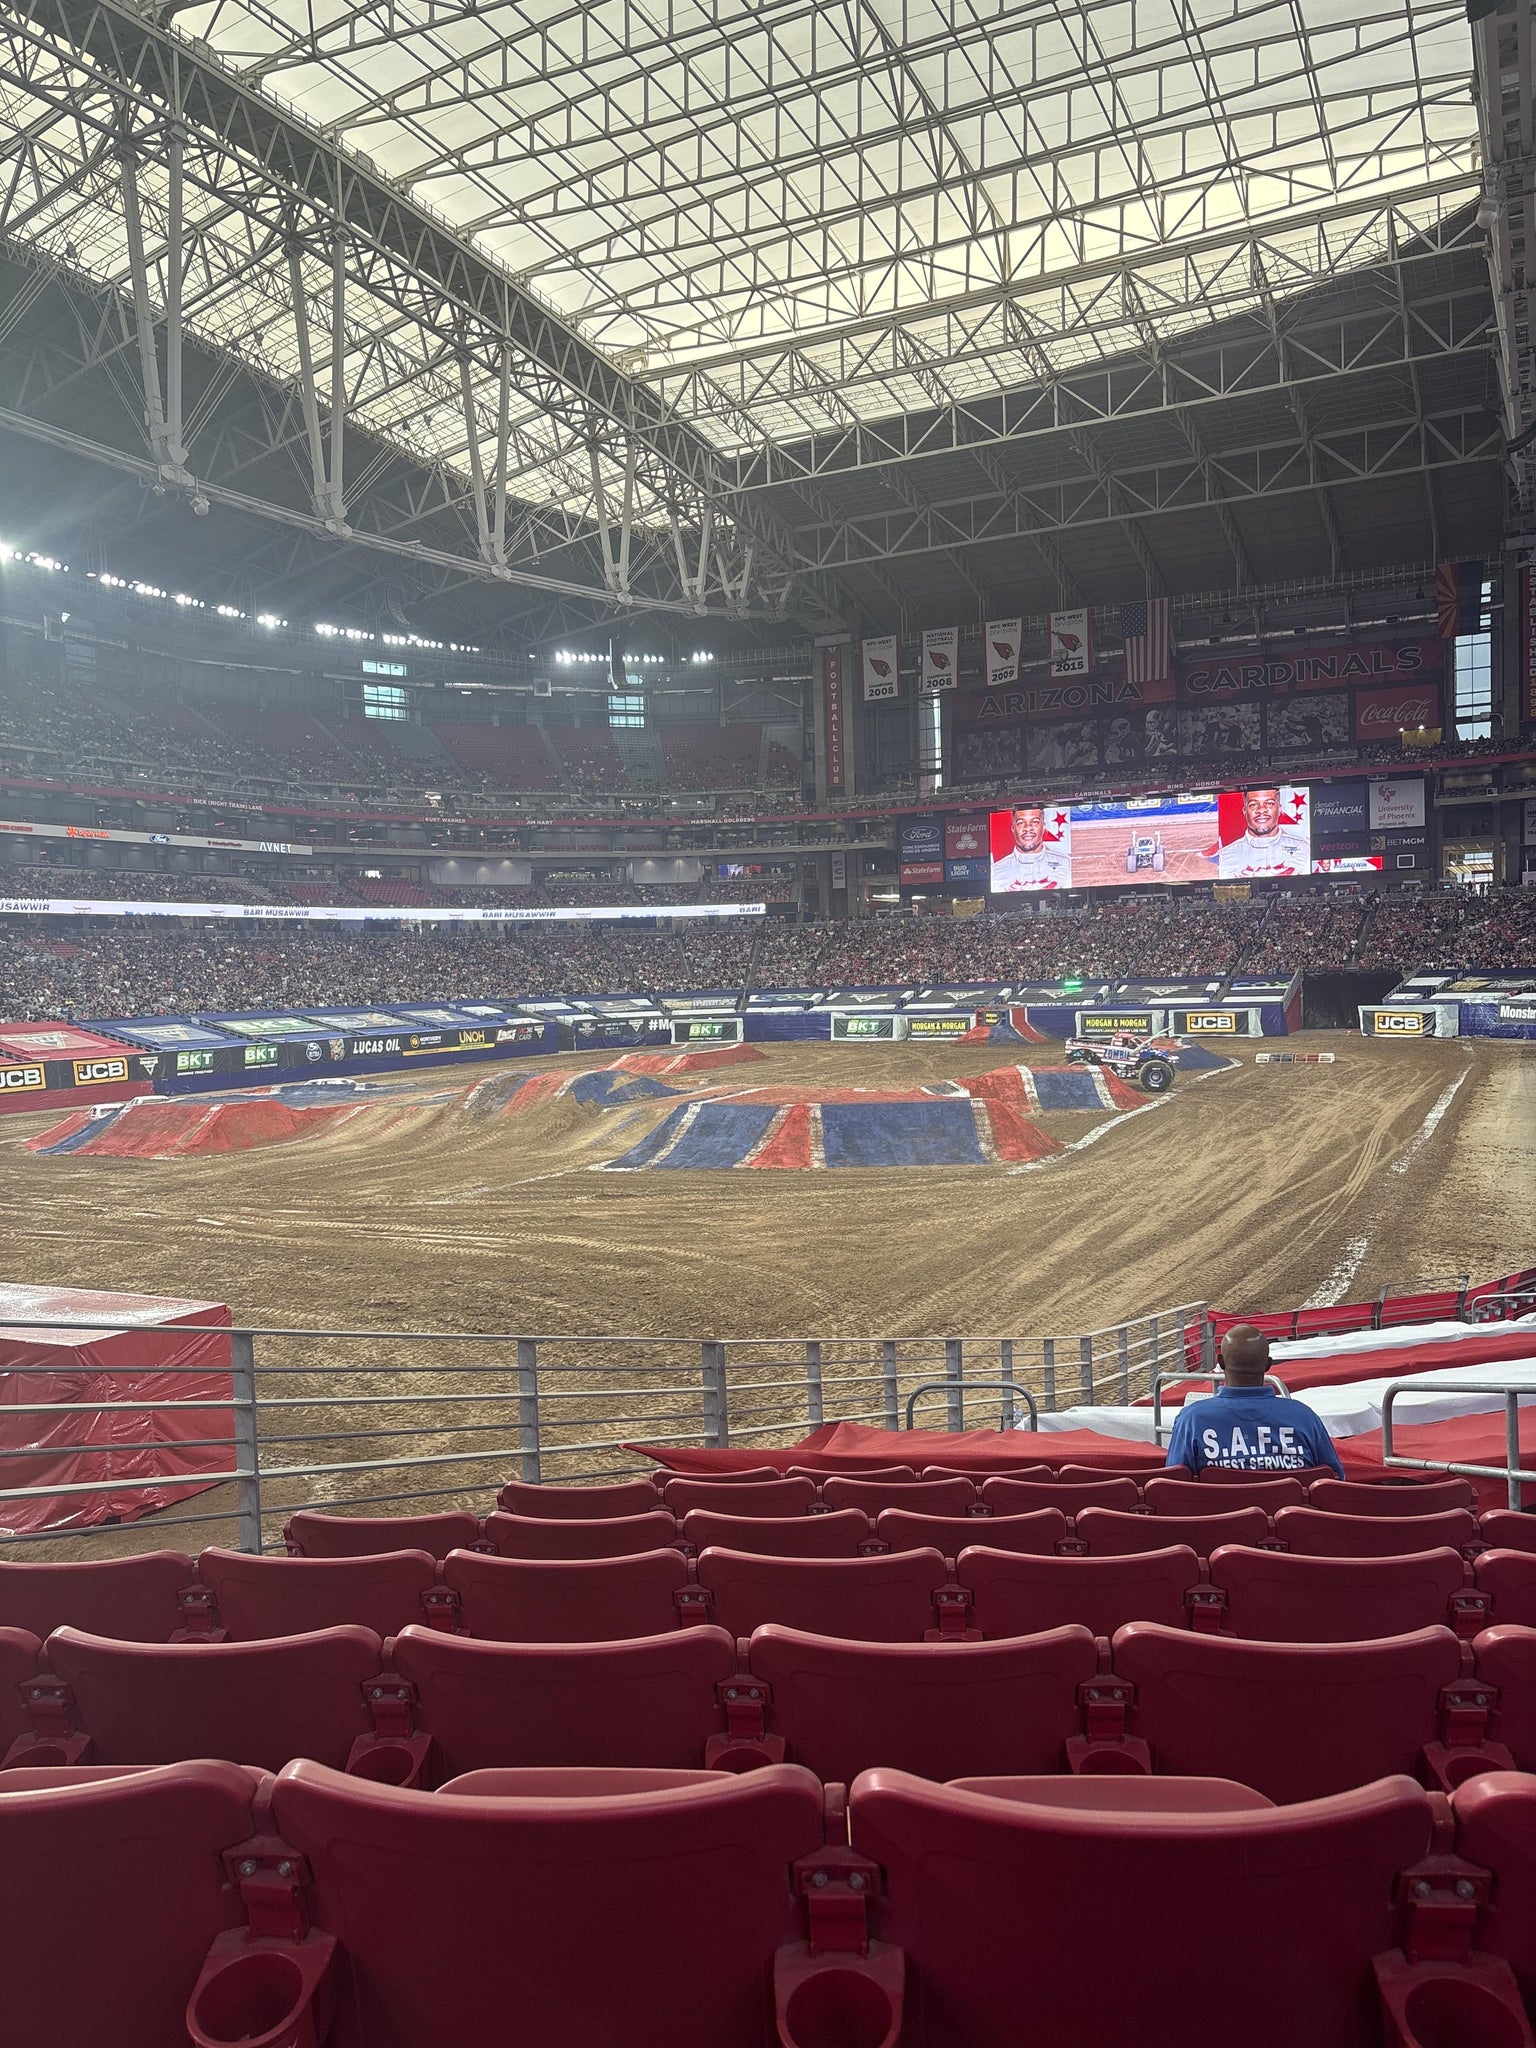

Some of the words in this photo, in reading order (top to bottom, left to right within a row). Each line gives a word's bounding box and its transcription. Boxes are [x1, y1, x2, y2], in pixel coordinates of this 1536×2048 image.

[1055, 661, 1085, 673] 2015
[1186, 646, 1423, 694] CARDINALS
[991, 670, 1015, 682] 2009
[926, 677, 953, 688] 2008
[868, 687, 894, 697] 2008
[977, 681, 1144, 718] ARIZONA
[1074, 789, 1112, 798] CARDINALS
[1378, 804, 1414, 812] University
[1387, 812, 1416, 820] Phoenix
[909, 828, 932, 839] Ford
[259, 841, 292, 853] AVNET
[1319, 841, 1359, 852] verizon
[265, 909, 310, 917] MUSAWWIR
[847, 1020, 879, 1032] BKT
[911, 1022, 935, 1030] MORGAN
[936, 1022, 941, 1030] &
[941, 1022, 966, 1030] MORGAN
[1086, 1018, 1112, 1027] MORGAN
[1113, 1019, 1119, 1027] &
[1119, 1018, 1147, 1027] MORGAN
[1190, 1017, 1232, 1029] JCB
[1378, 1016, 1419, 1030] JCB
[690, 1025, 723, 1035] BKT
[458, 1030, 485, 1044] UNOH
[353, 1040, 384, 1054] LUCAS
[386, 1038, 401, 1051] OIL
[177, 1053, 213, 1067] BKT
[245, 1047, 278, 1061] BKT
[79, 1062, 124, 1080] JCB
[1202, 1426, 1304, 1459] S.A.F.E.
[1249, 1454, 1305, 1470] SERVICES
